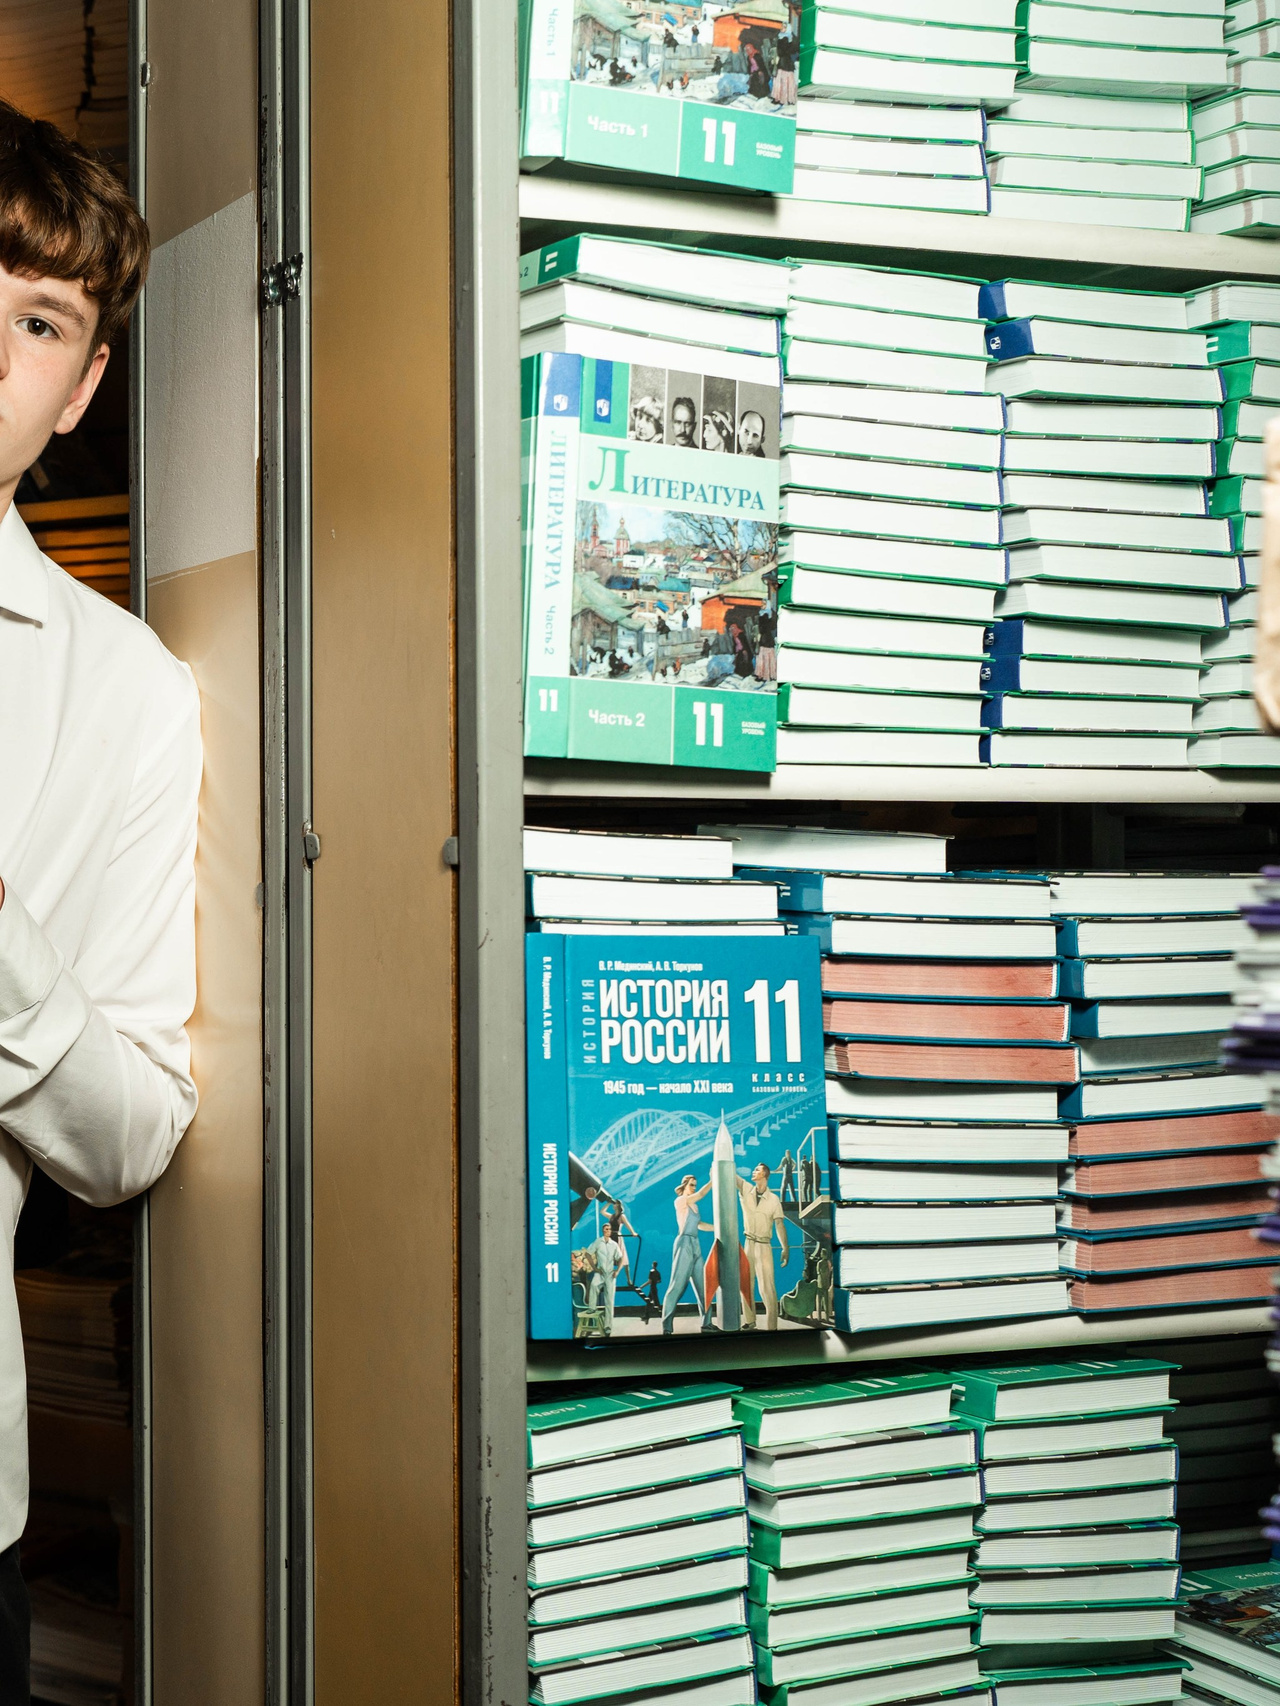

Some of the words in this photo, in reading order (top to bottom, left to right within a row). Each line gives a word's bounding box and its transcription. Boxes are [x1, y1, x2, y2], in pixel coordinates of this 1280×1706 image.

[587, 115, 636, 136] Часть
[640, 124, 648, 138] 1
[702, 117, 736, 166] 11
[544, 430, 568, 590] ЛИТЕРАТУРА
[545, 605, 557, 644] Часть
[544, 647, 555, 656] 2
[538, 688, 559, 712] 11
[588, 709, 632, 727] Часть
[635, 712, 646, 728] 2
[692, 701, 724, 747] 11
[599, 978, 729, 1019] ИСТОРИЯ
[581, 979, 597, 1064] ИСТОРИЯ
[600, 1018, 731, 1065] РОССИИ
[744, 979, 802, 1063] 11
[603, 1080, 626, 1095] 1945
[627, 1083, 646, 1096] год
[658, 1082, 692, 1094] начало
[711, 1082, 734, 1094] века
[542, 1143, 559, 1196] ИСТОРИЯ
[543, 1199, 559, 1246] РОССИИ
[544, 1262, 559, 1284] 11
[528, 1406, 577, 1417] Часть
